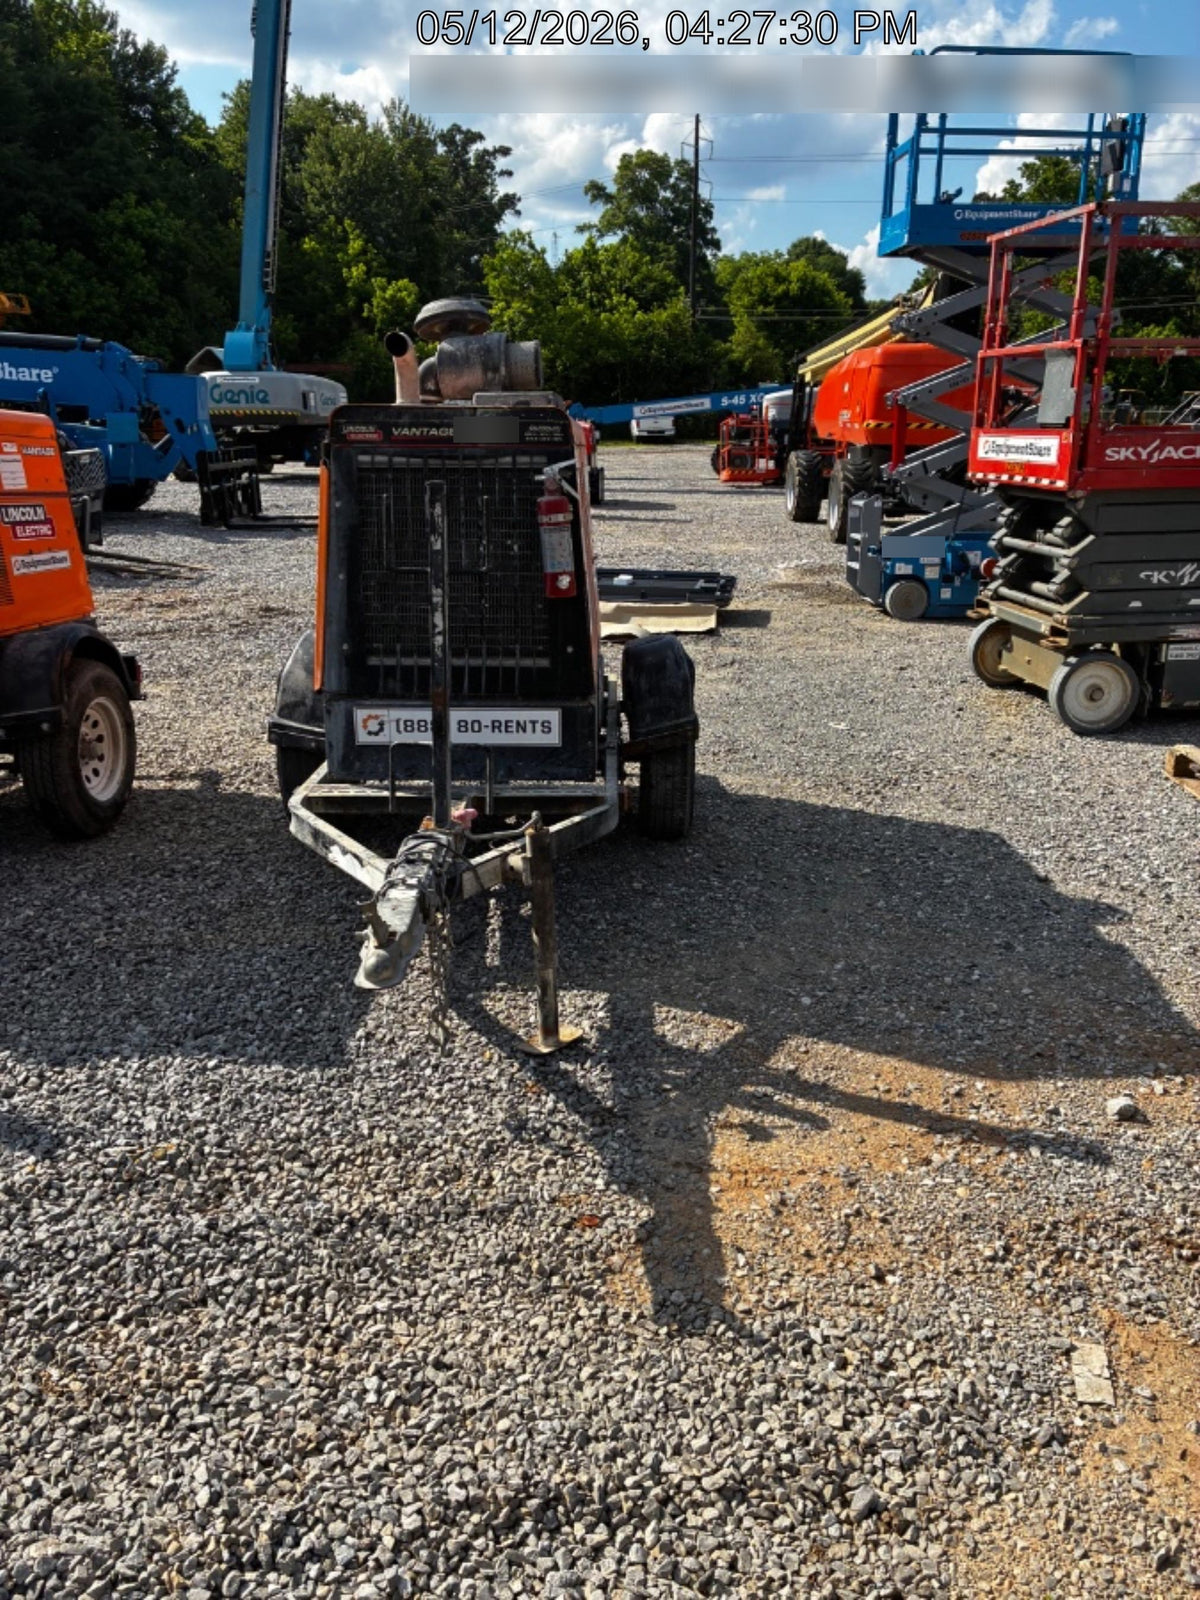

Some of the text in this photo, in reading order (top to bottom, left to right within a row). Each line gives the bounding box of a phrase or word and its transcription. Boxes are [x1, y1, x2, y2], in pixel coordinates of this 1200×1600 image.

[964, 209, 1038, 221] EquipmentShare
[0, 362, 54, 383] hare
[209, 383, 270, 404] Genie
[720, 395, 746, 407] S-45
[1105, 439, 1200, 463] SKYJAC
[1, 506, 45, 522] LINCOLN
[15, 524, 52, 537] ELECTRIC
[395, 713, 552, 735] (88 80-RENTS
